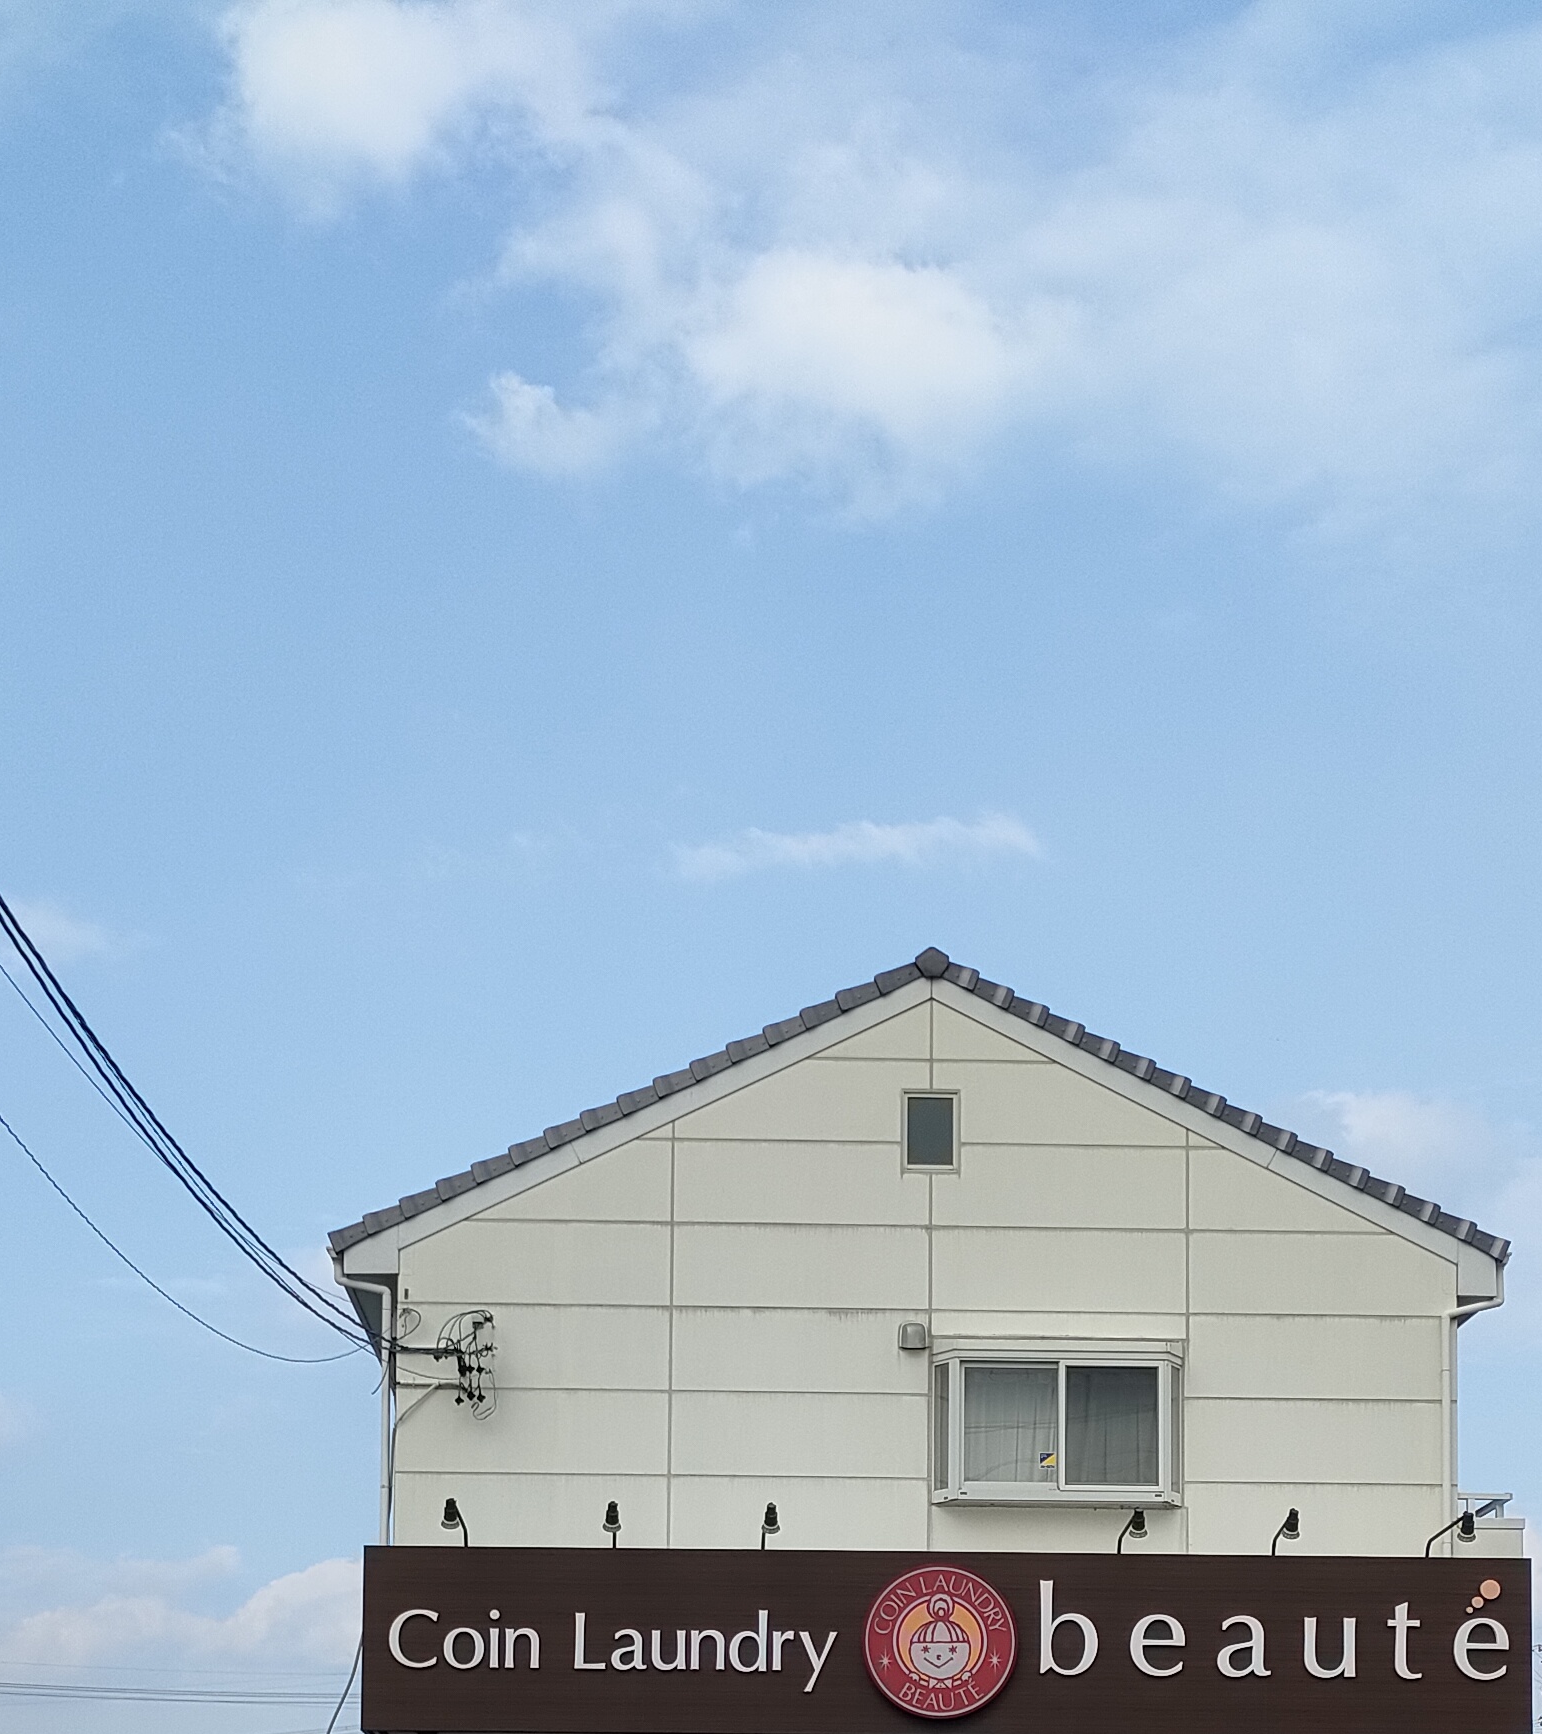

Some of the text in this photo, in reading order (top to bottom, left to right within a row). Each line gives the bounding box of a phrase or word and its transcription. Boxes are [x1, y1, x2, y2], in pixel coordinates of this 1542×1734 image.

[874, 1574, 1007, 1634] COIN LAUNDRY
[1039, 1579, 1510, 1681] beauté
[388, 1608, 839, 1693] Coin Laundry
